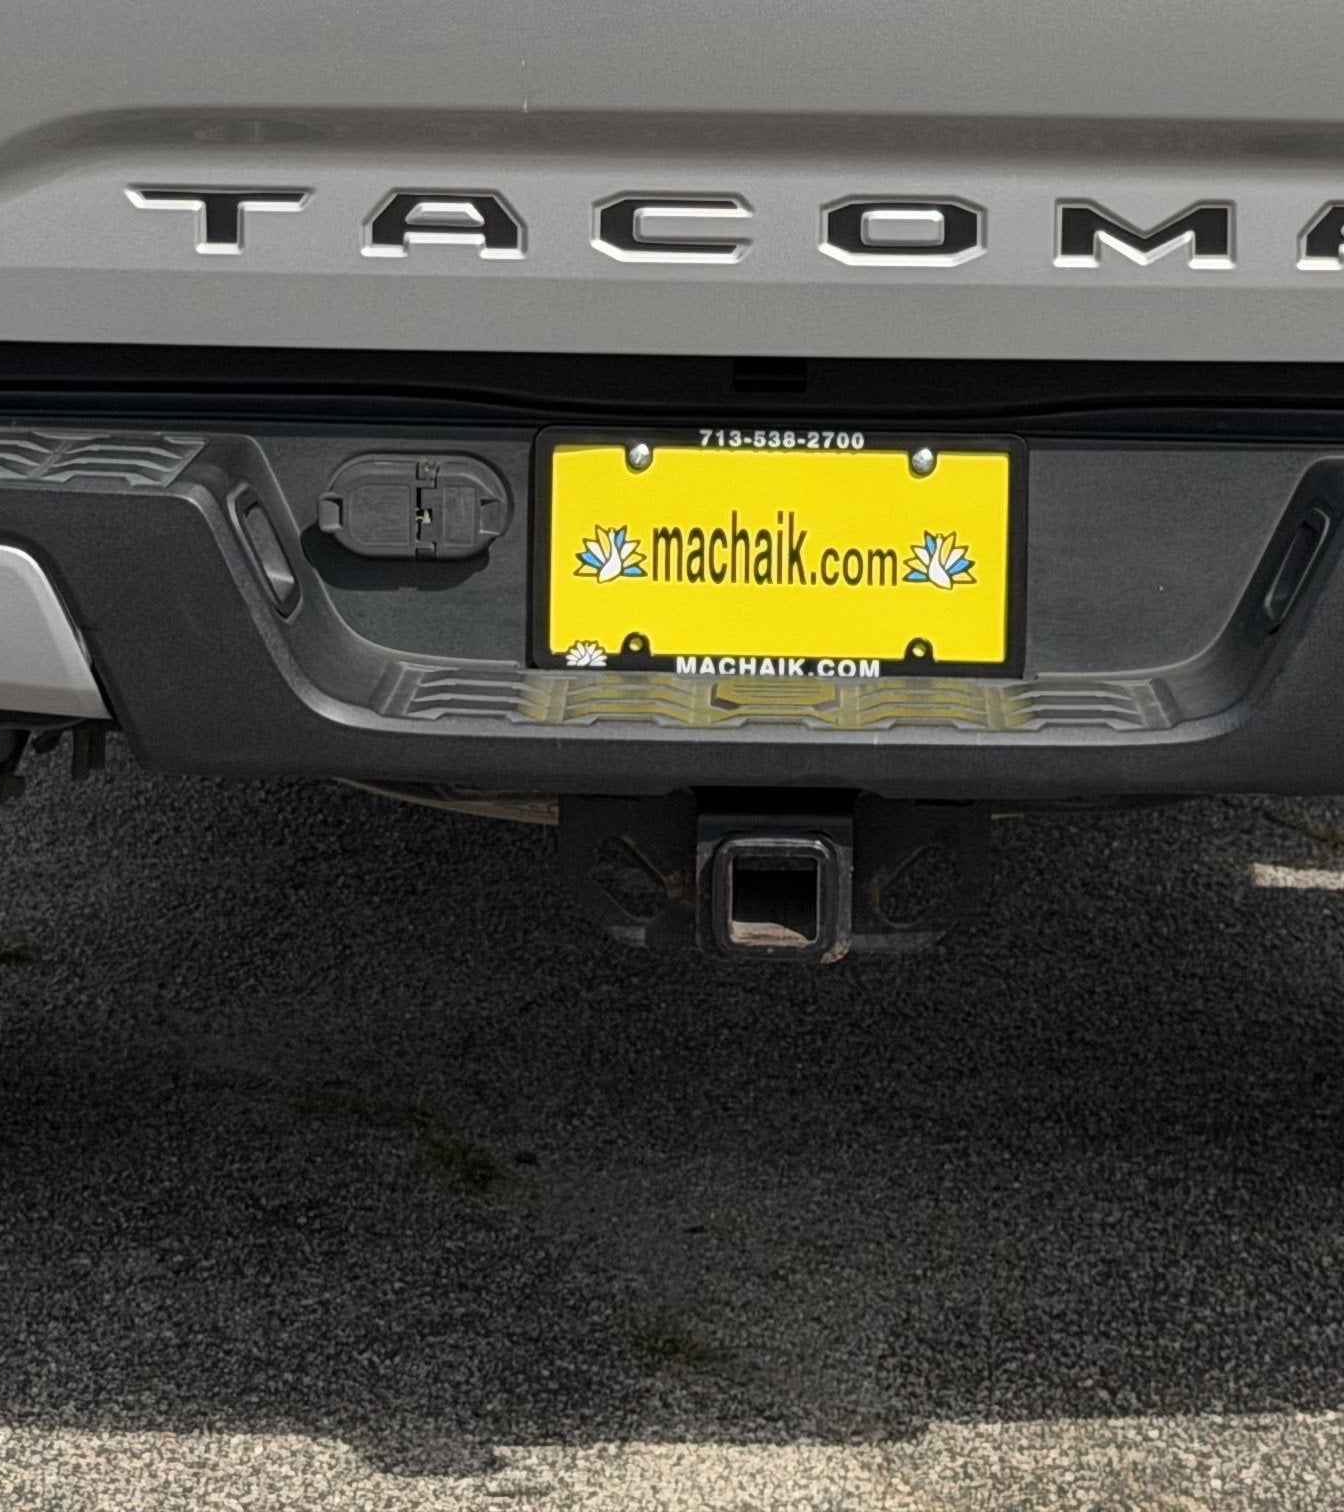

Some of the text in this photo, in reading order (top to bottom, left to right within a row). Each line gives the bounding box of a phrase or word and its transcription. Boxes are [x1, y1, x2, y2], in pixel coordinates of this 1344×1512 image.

[699, 429, 865, 449] 713-538-2700
[652, 510, 897, 586] machaik.com
[676, 656, 880, 677] MACHAIK.COM
